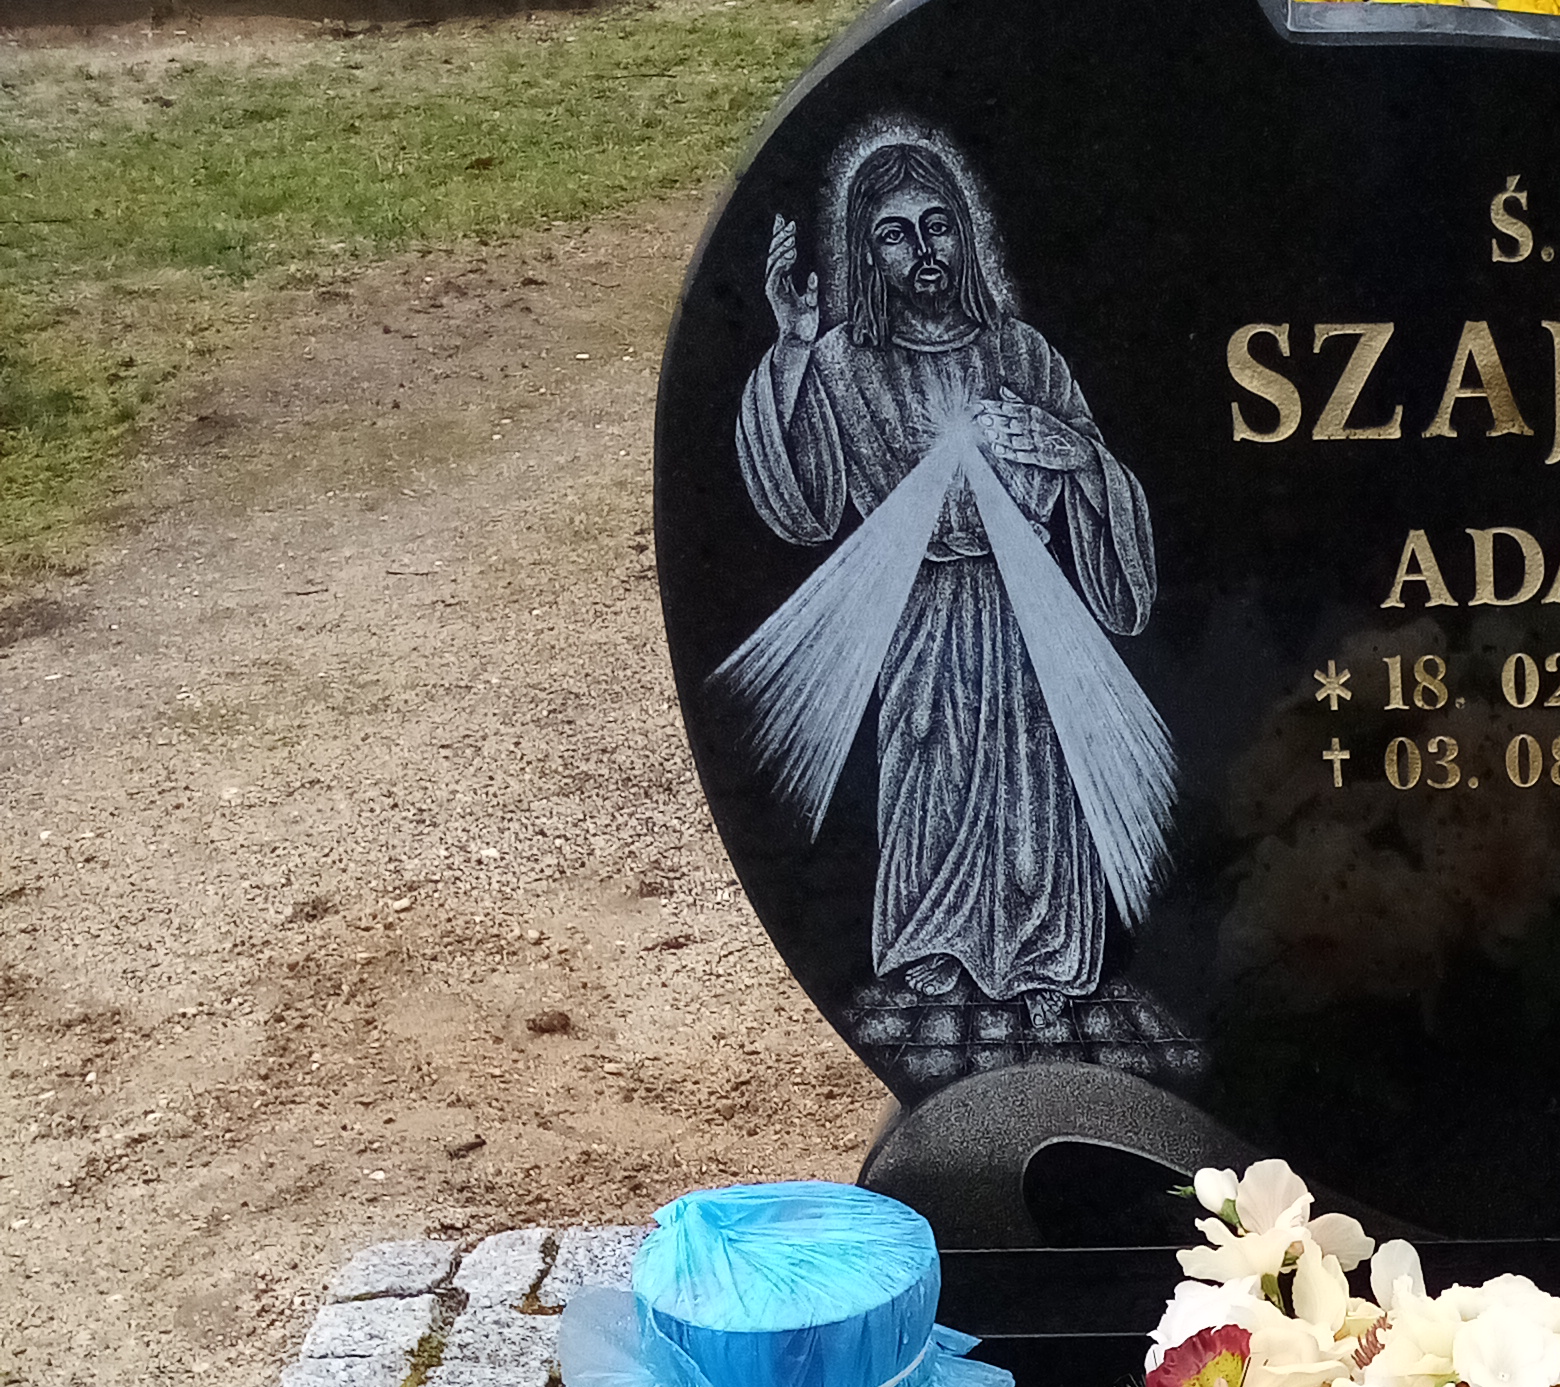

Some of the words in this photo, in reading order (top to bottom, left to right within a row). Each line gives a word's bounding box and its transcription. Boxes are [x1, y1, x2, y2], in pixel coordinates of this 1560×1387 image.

[1489, 174, 1555, 264] Ś.
[1382, 653, 1466, 711] 18.
[1383, 735, 1480, 790] 03.
